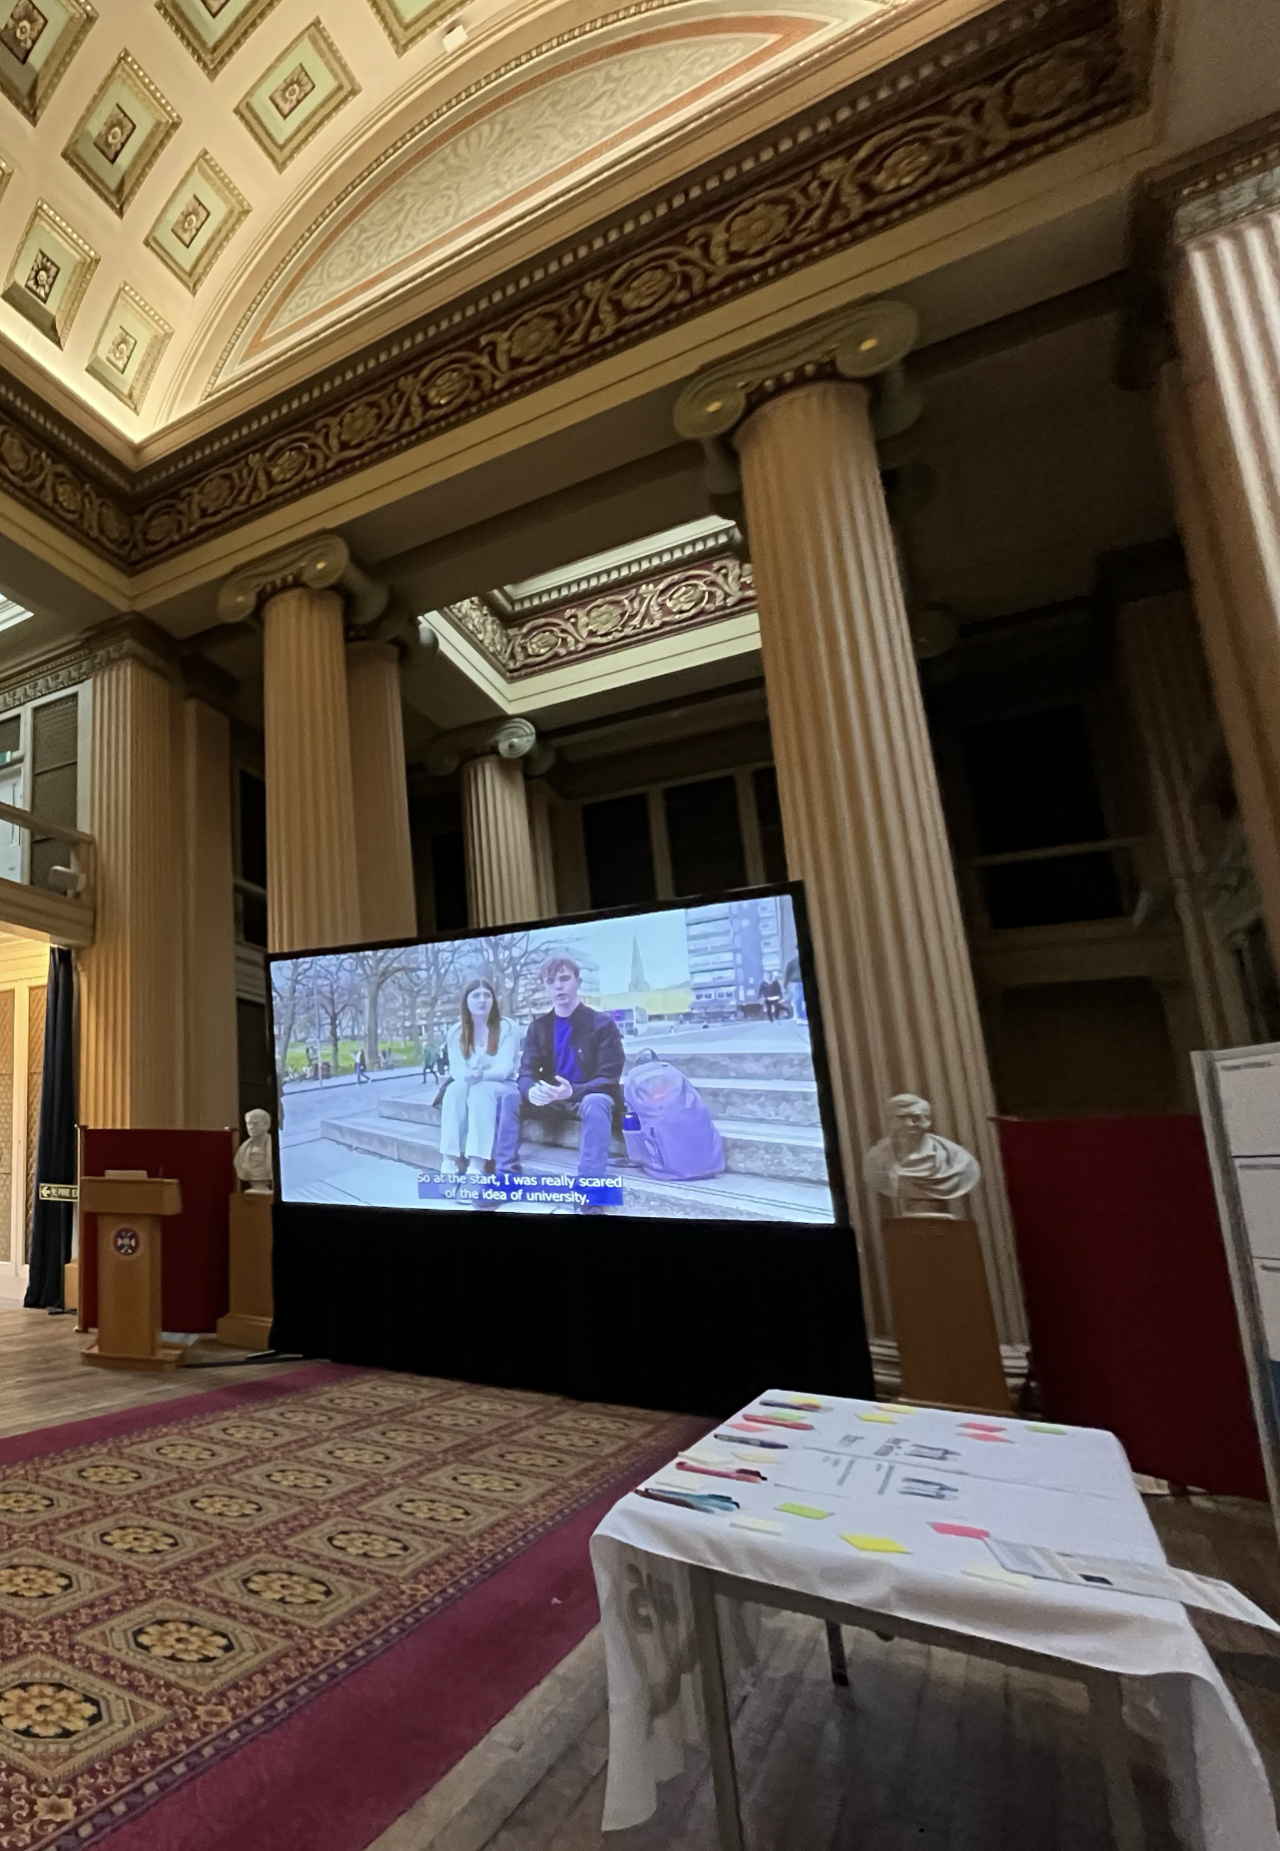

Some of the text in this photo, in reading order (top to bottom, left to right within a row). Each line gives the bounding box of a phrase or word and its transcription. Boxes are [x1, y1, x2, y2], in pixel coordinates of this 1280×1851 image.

[417, 1174, 623, 1188] So at the start, I was really scared
[445, 1189, 590, 1205] of the idea of university.
